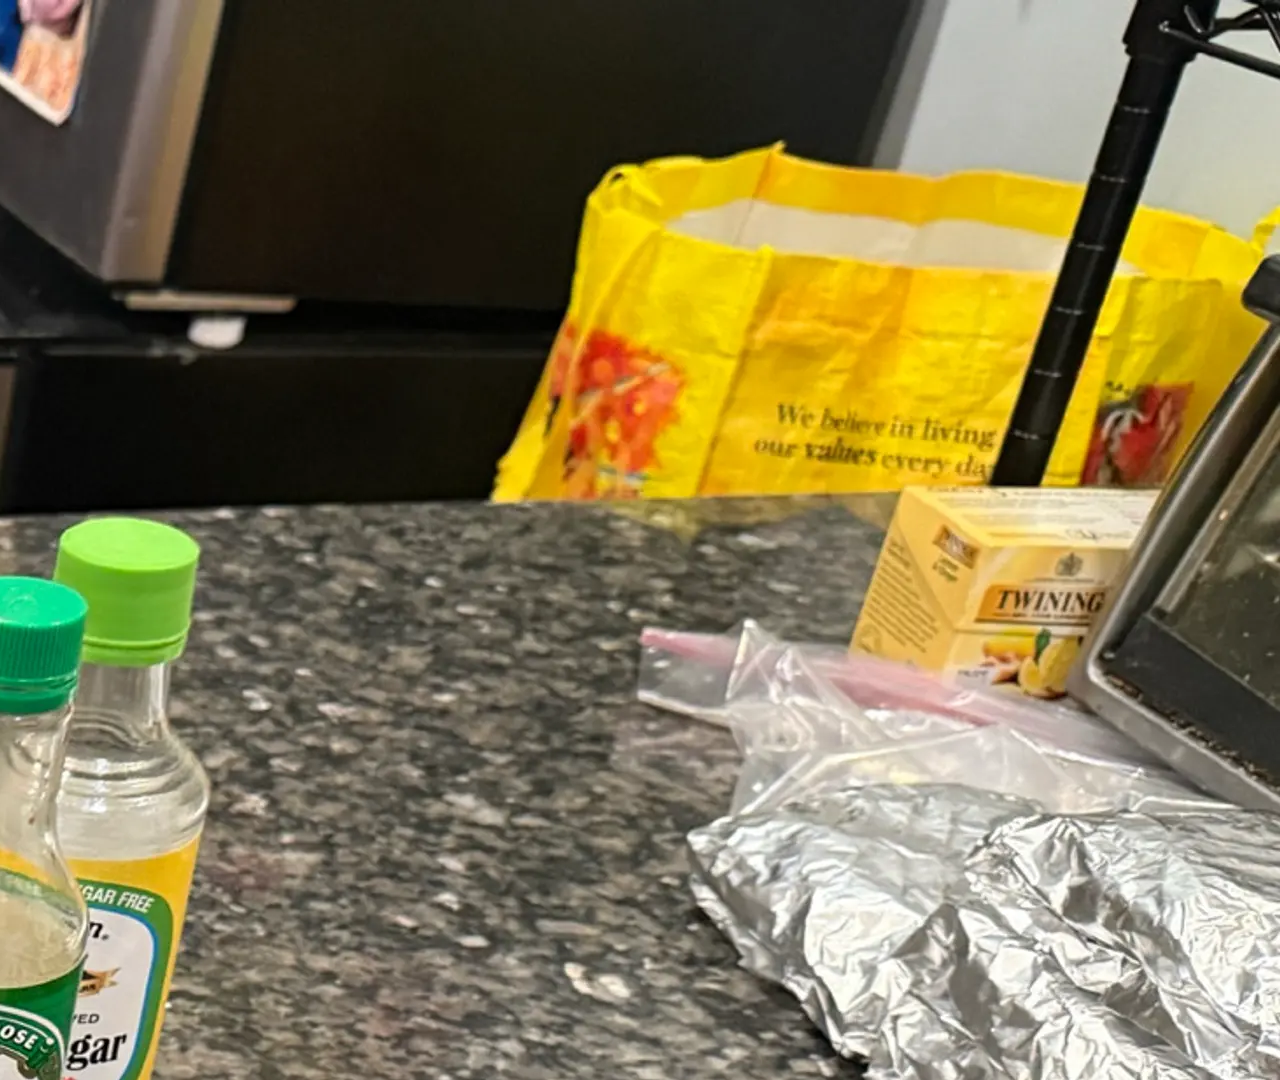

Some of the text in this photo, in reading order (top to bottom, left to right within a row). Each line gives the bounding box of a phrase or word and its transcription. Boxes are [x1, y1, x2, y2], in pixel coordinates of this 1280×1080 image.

[777, 403, 997, 451] We believe in living
[753, 437, 992, 480] our values every da
[996, 589, 1105, 613] TWINING
[79, 884, 156, 914] GAR FREE
